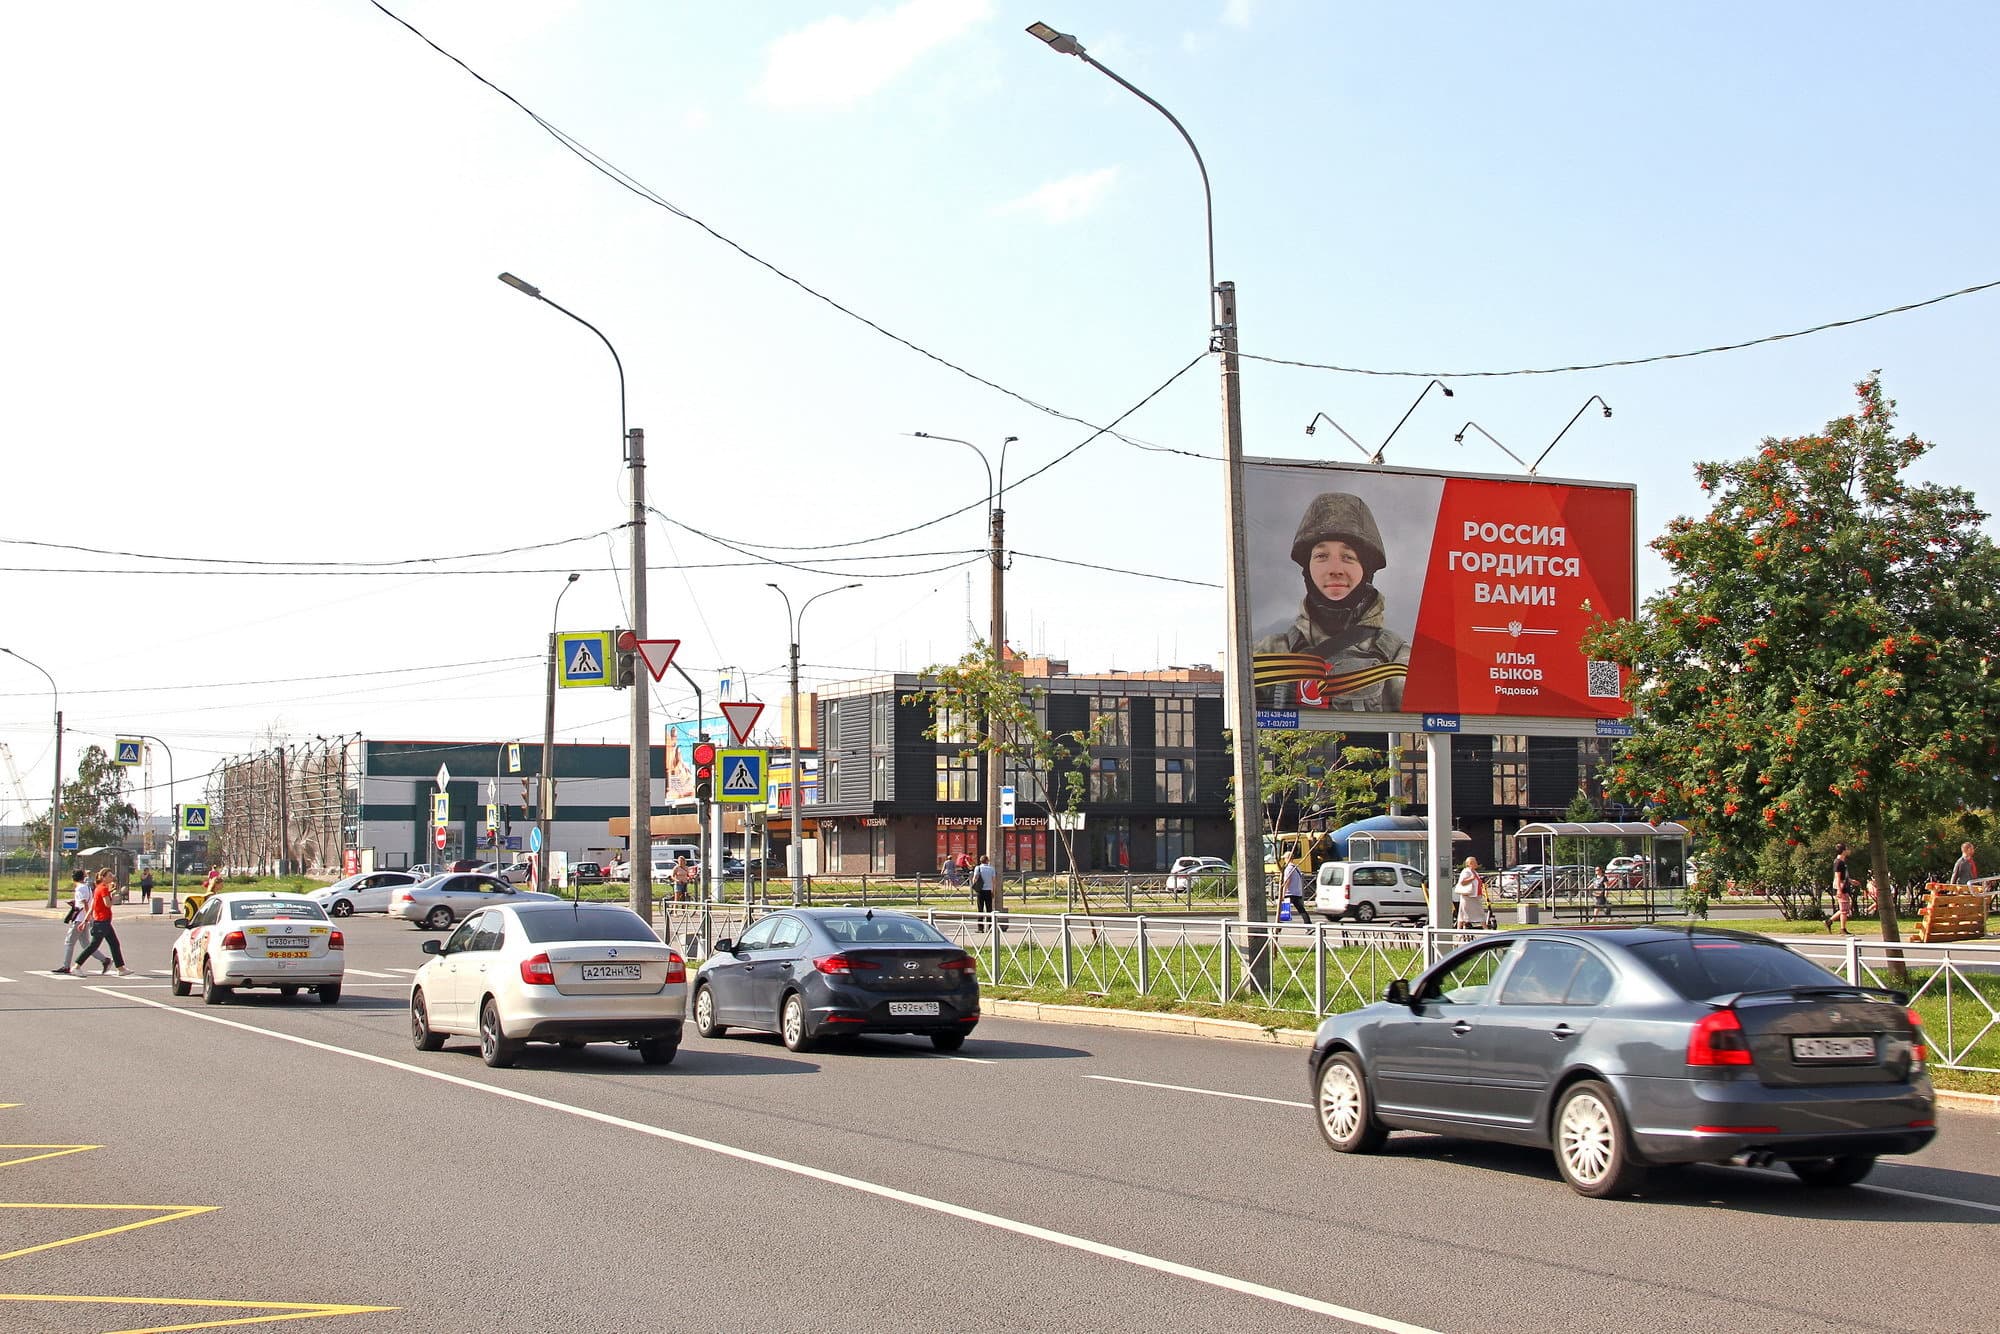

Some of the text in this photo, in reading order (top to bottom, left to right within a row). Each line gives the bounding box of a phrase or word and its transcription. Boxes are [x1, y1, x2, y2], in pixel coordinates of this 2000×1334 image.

[1463, 521, 1565, 547] РОССИЯ
[1448, 550, 1580, 577] ГОРДИТСЯ
[1474, 582, 1556, 606] ВАМИ!
[1496, 652, 1535, 665] ИЛЬЯ
[1489, 667, 1543, 681] БЫКОВ
[1494, 685, 1539, 696] Рядовой
[1436, 718, 1457, 728] Russ
[937, 817, 983, 826] ПЕКАРНЯ
